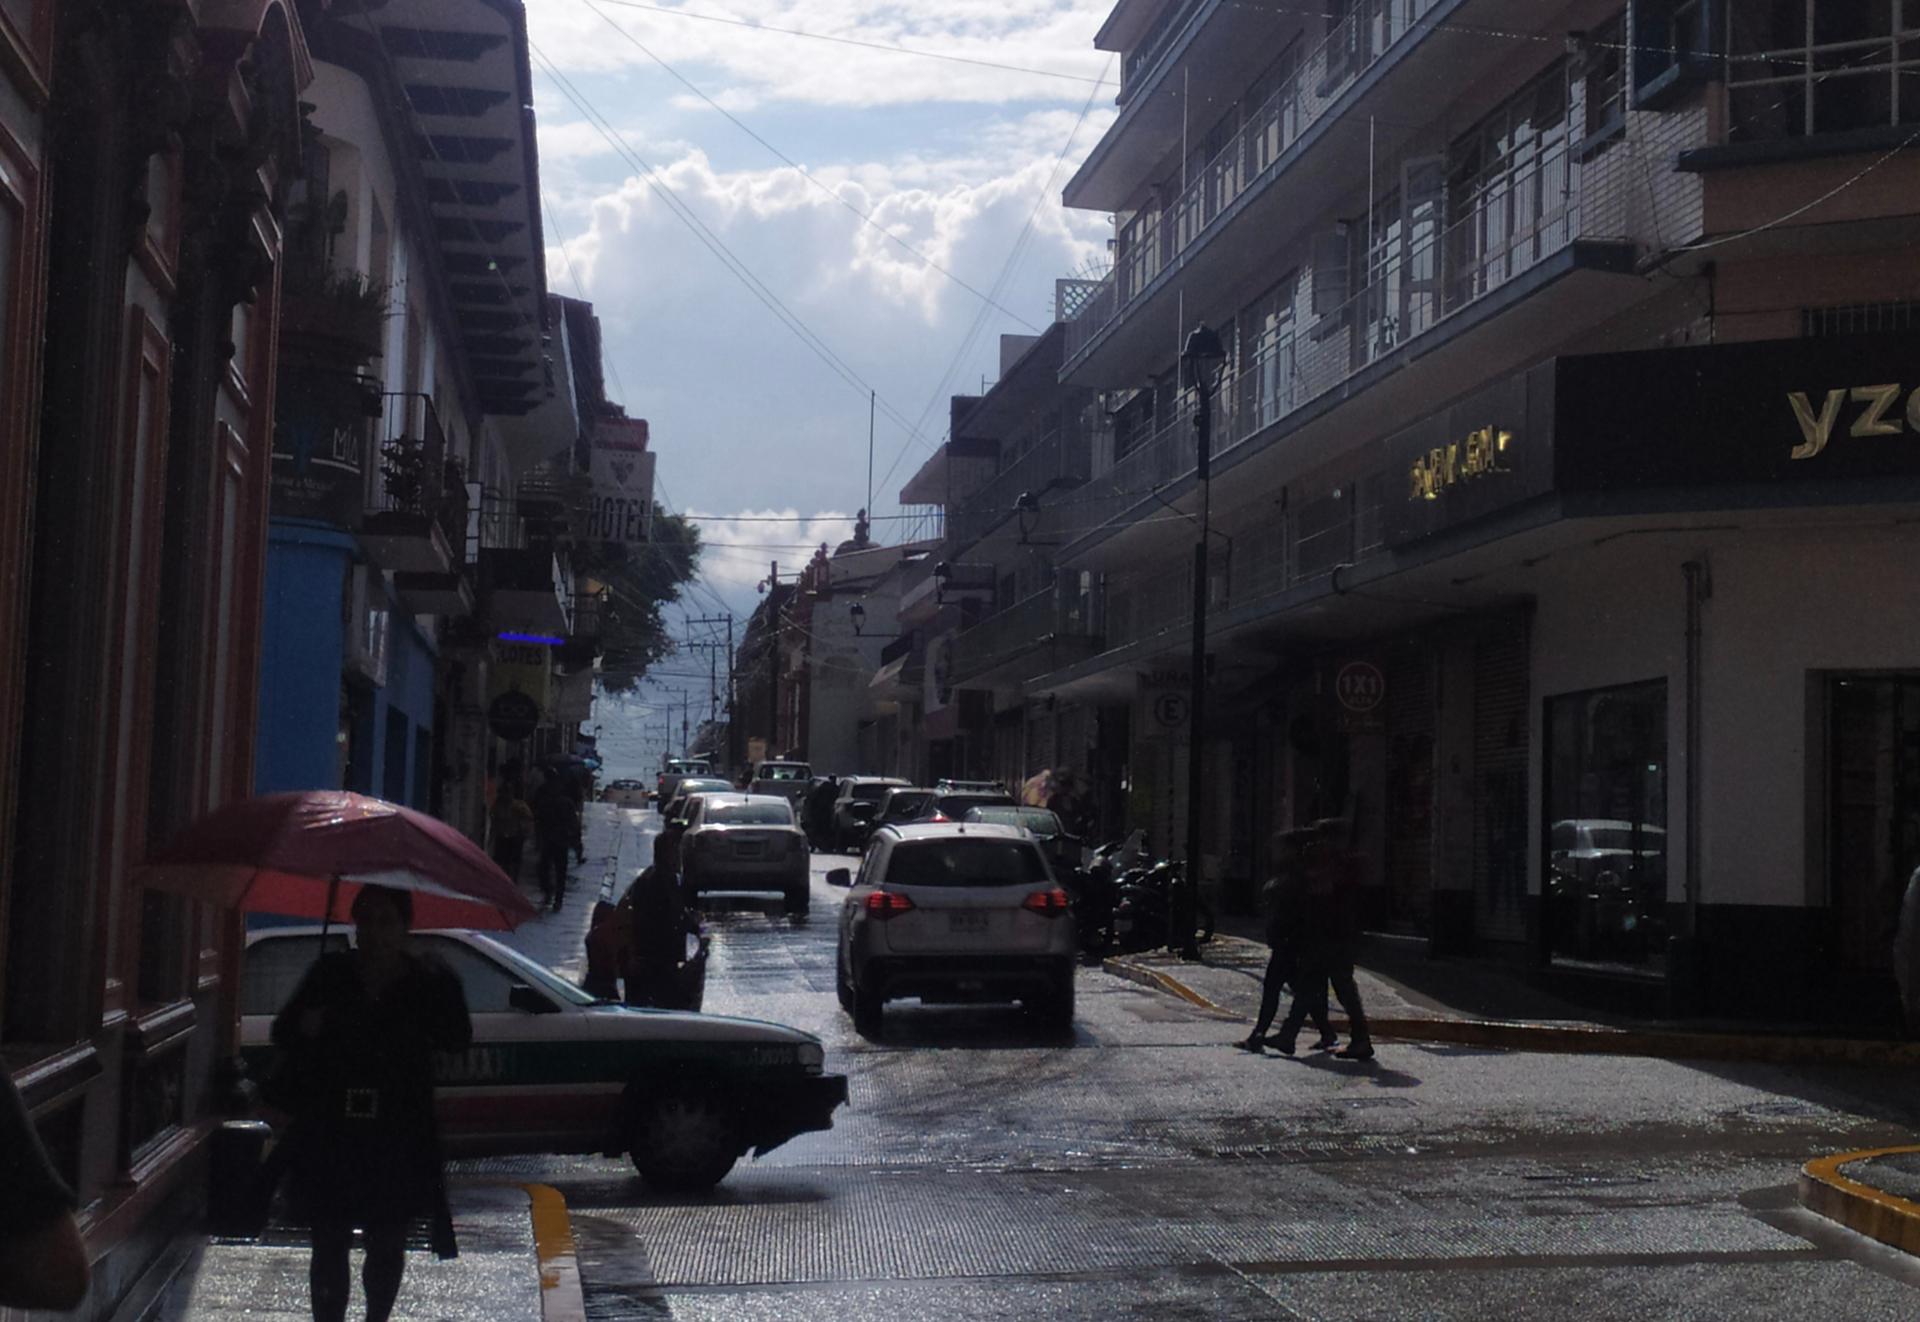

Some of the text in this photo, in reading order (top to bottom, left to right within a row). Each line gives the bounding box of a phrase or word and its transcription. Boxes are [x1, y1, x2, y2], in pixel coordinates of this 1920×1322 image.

[1786, 383, 1920, 460] yz
[588, 494, 649, 542] HOTEL
[1164, 699, 1179, 720] E
